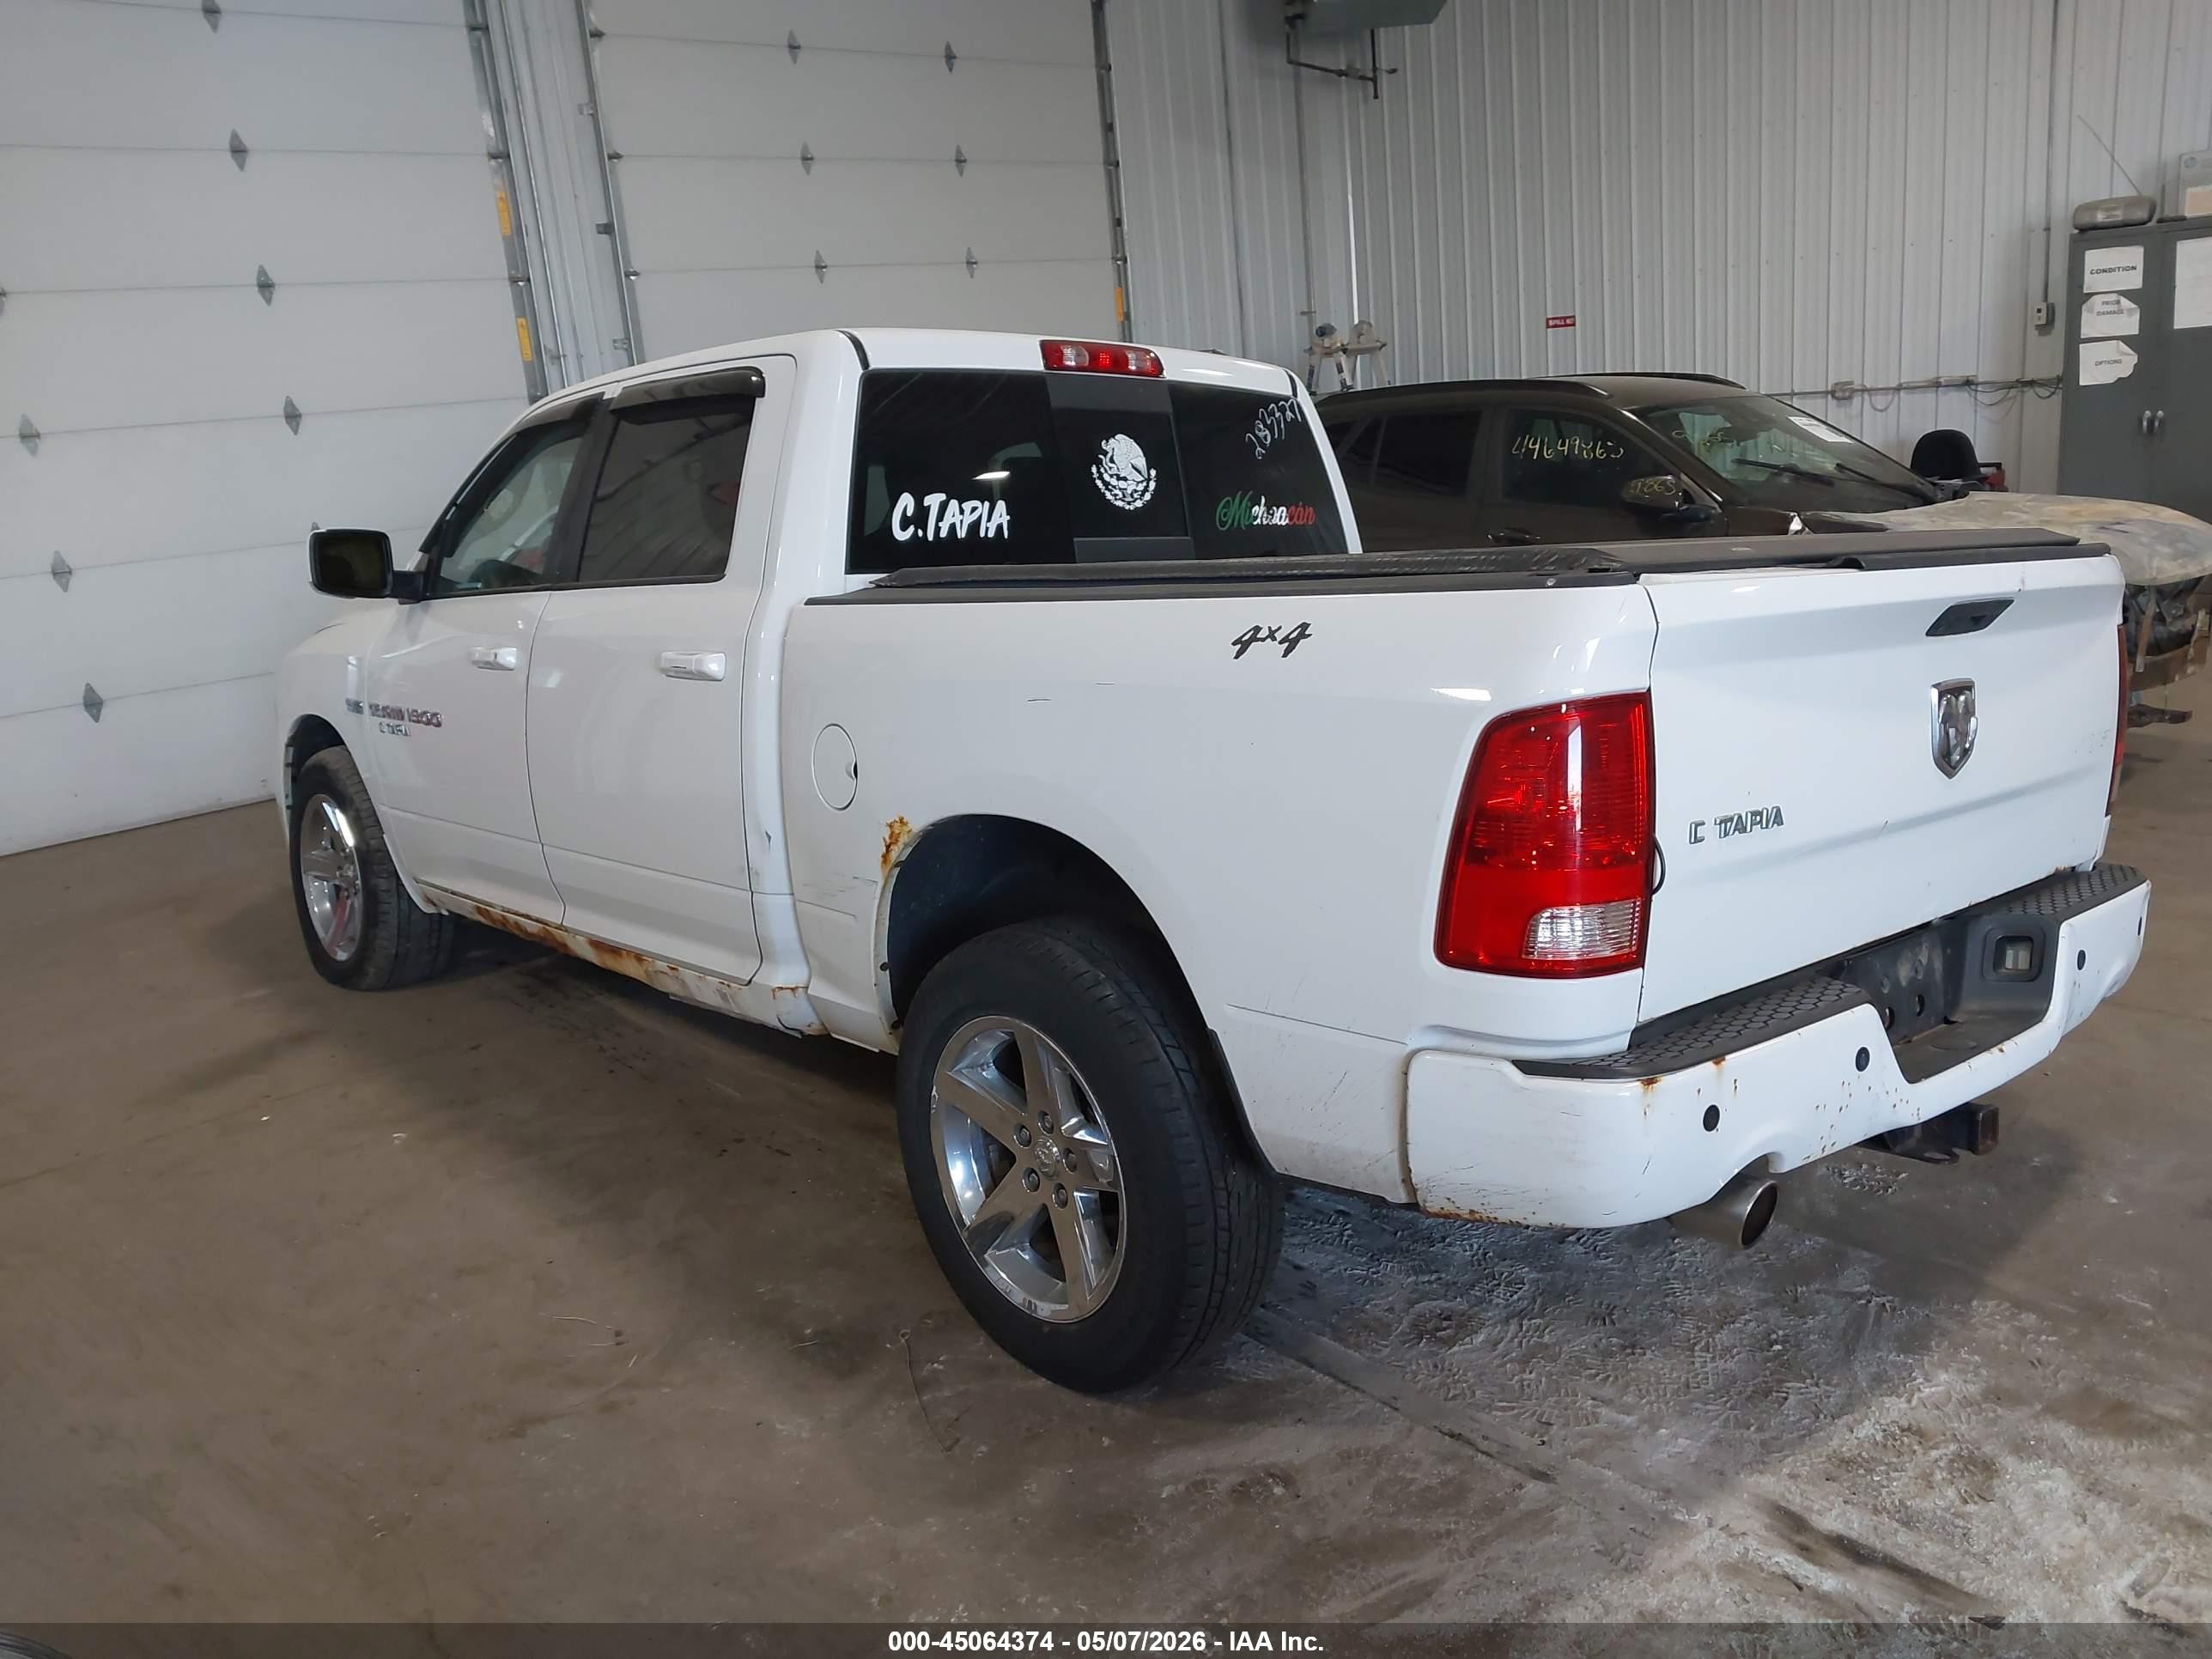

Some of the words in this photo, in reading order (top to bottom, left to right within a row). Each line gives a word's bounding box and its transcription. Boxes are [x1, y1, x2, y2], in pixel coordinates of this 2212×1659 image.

[2089, 265, 2137, 276] CONDITION
[891, 491, 1011, 542] C.TAPIA
[1231, 622, 1313, 660] 4x4
[1688, 819, 1706, 844] C
[1714, 805, 1784, 839] TAPIA
